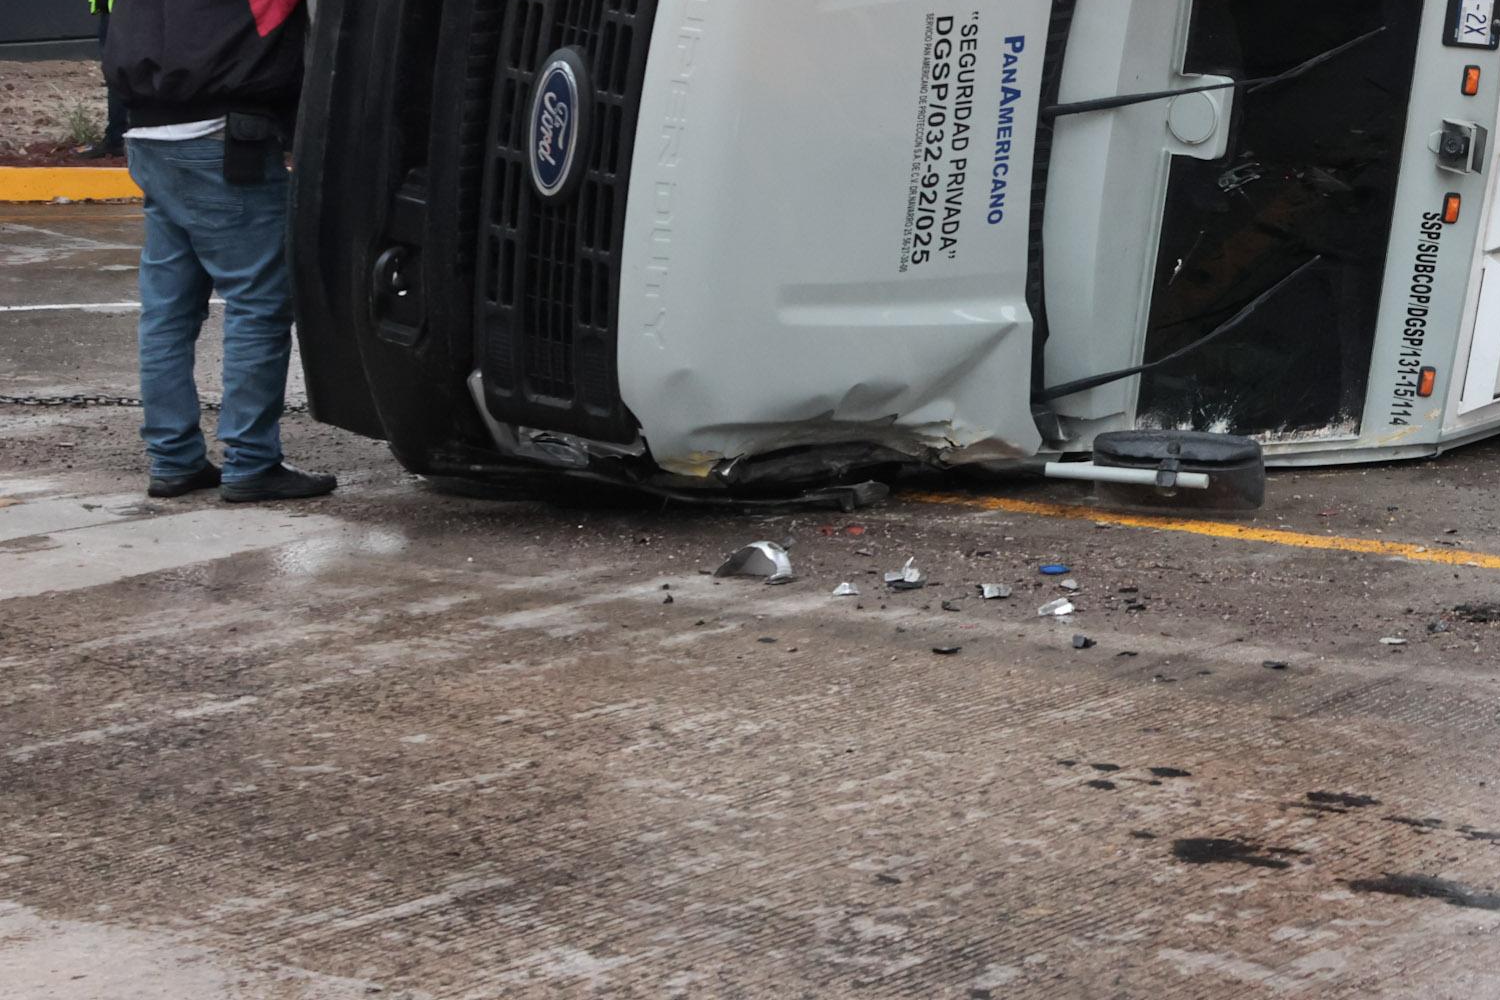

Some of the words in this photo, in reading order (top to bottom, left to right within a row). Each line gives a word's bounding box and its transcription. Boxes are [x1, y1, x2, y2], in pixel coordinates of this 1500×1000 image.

[919, 96, 928, 104] DE
[920, 57, 931, 94] AMERICANO
[923, 43, 932, 56] PAN
[952, 11, 979, 151] "SEGURIDAD
[538, 92, 568, 165] Ford
[911, 16, 953, 265] DGSP/032-92/025
[938, 158, 968, 259] PRIVADA"
[643, 181, 676, 350] DUTY
[1389, 212, 1442, 426] SSP/SUBCOP/DGSP/131-15/114
